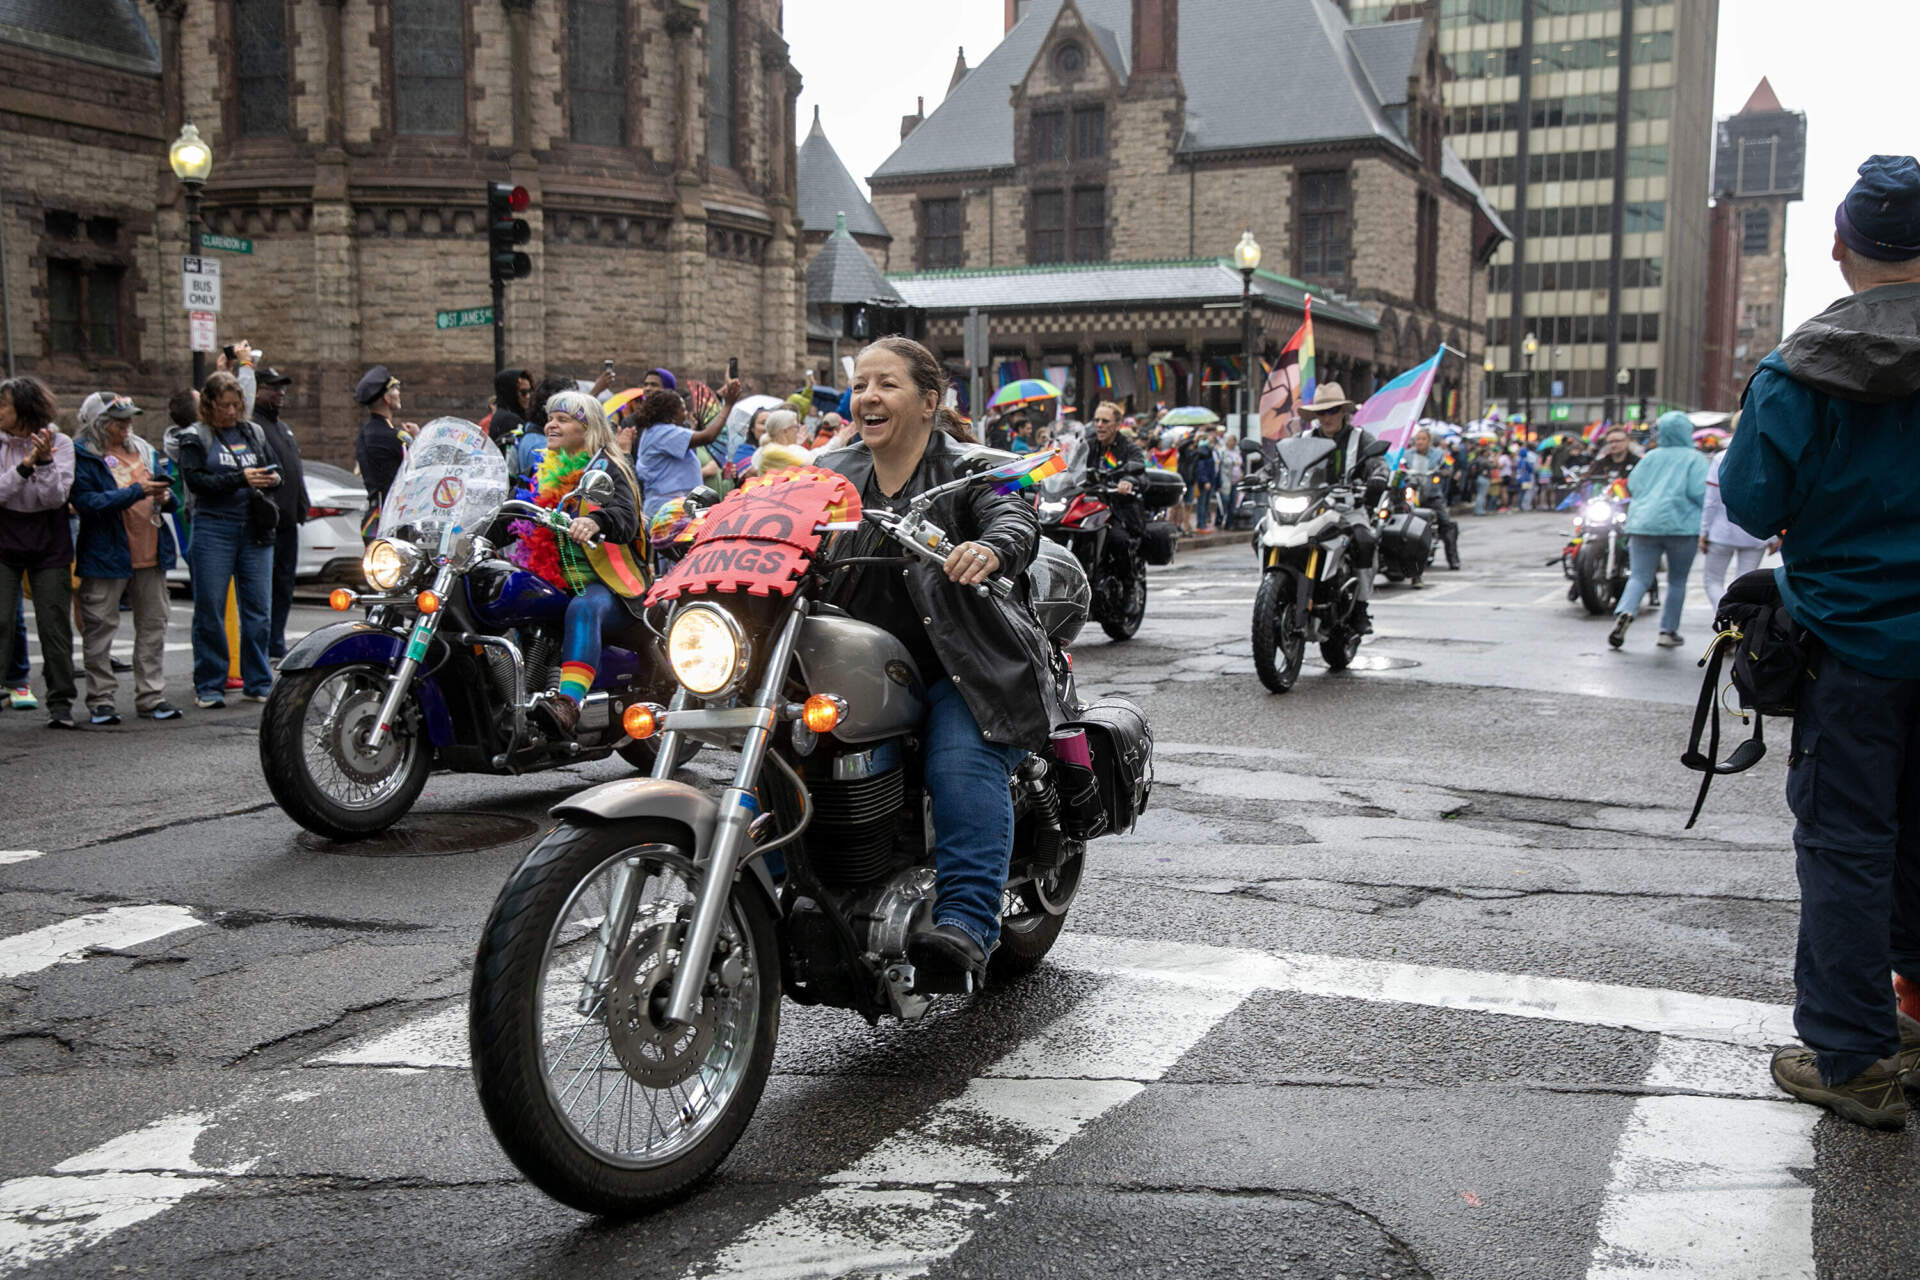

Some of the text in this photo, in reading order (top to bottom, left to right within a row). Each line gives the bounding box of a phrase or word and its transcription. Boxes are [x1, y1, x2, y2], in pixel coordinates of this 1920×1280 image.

[202, 235, 240, 249] CLARENDON
[193, 280, 212, 292] BUS
[189, 294, 216, 305] ONLY
[448, 312, 456, 327] ST
[459, 309, 486, 326] JAMES
[444, 467, 464, 477] NO
[703, 513, 793, 548] NO
[684, 549, 785, 577] KINGS
